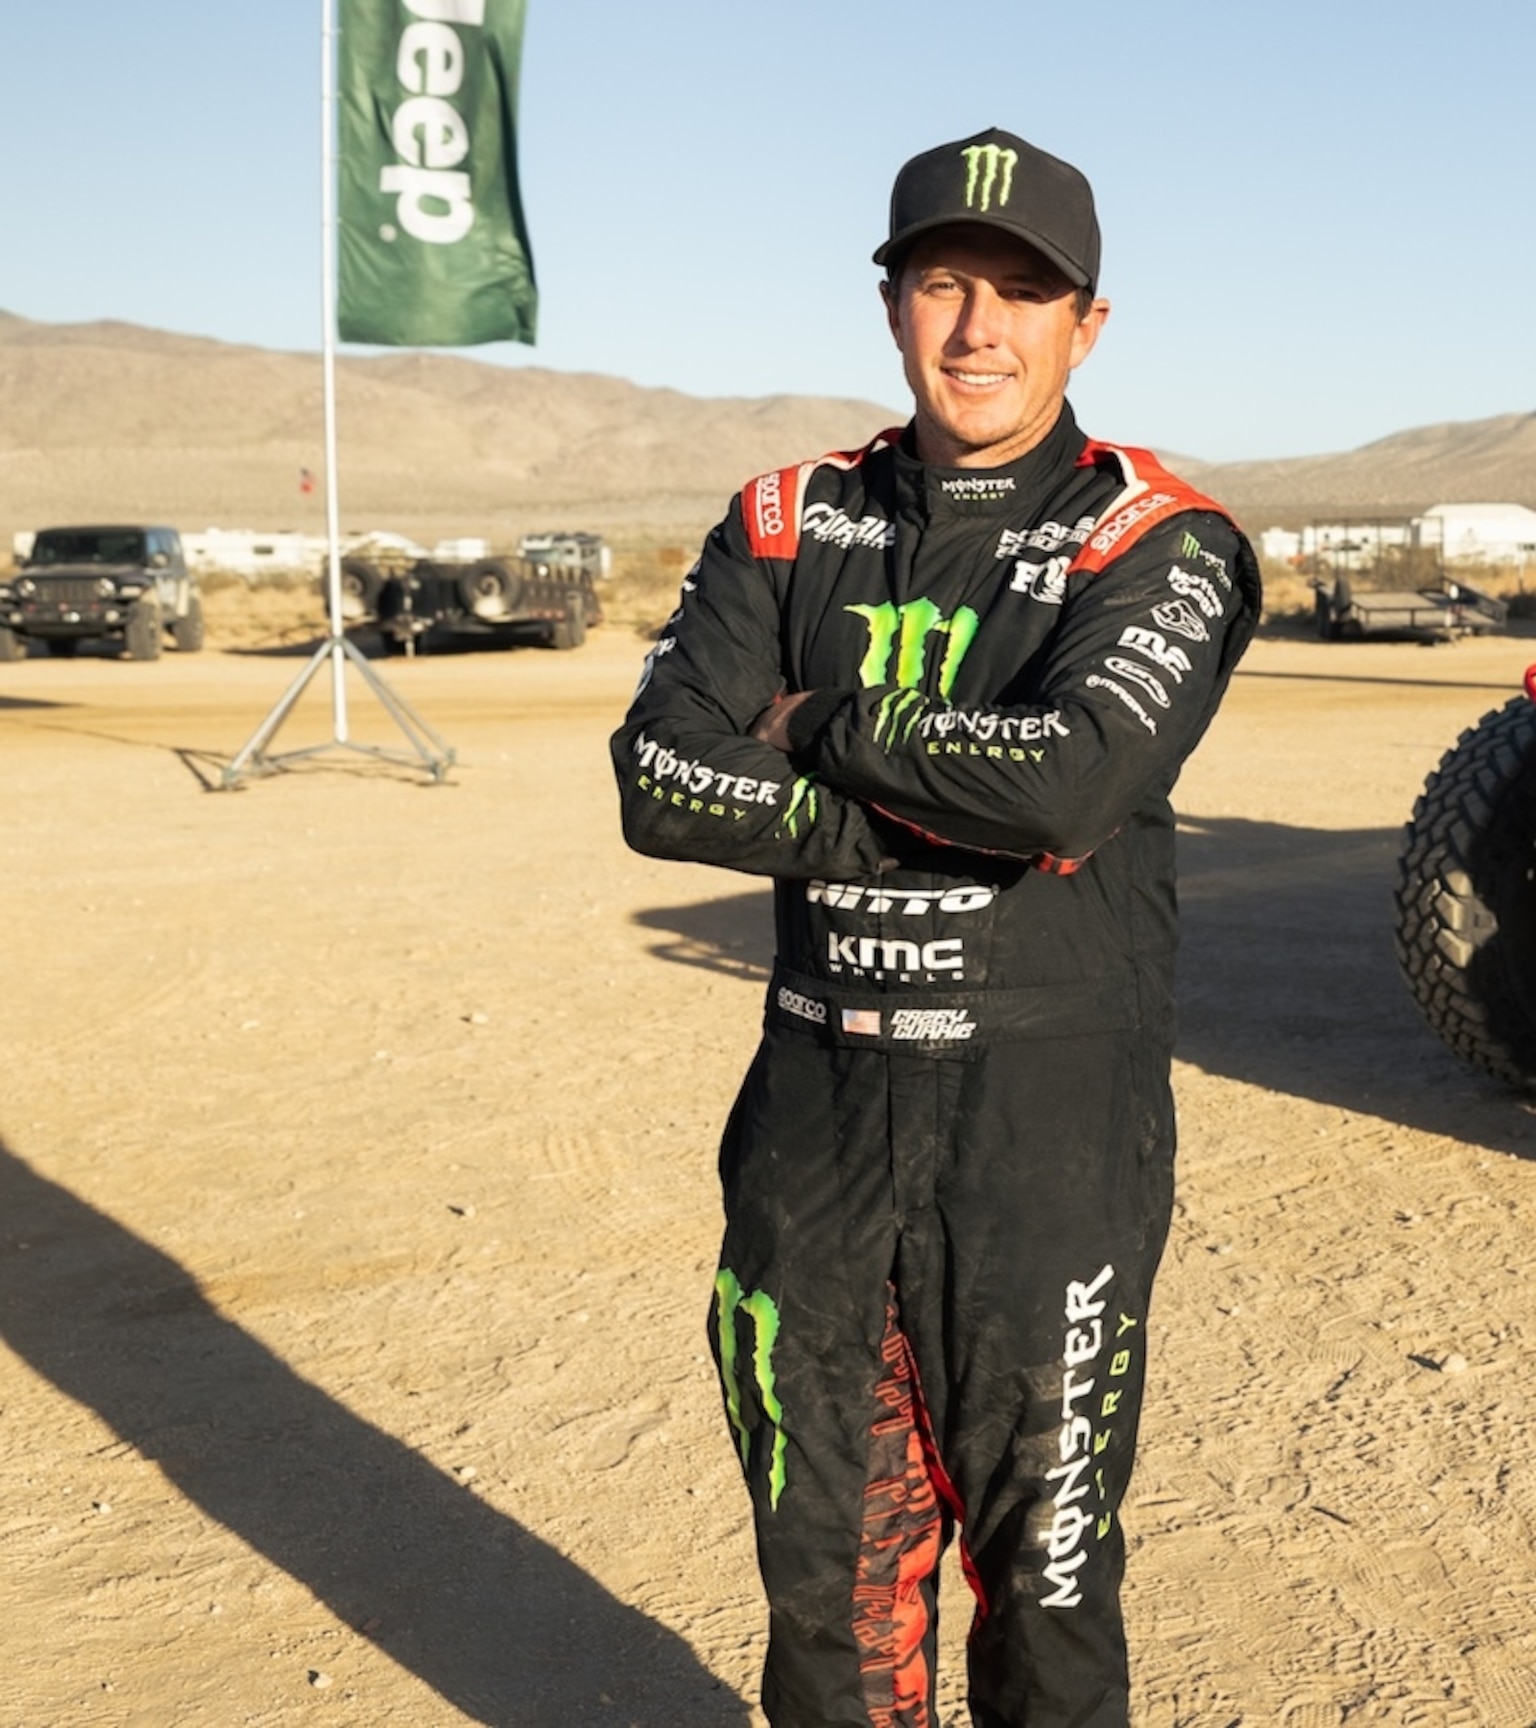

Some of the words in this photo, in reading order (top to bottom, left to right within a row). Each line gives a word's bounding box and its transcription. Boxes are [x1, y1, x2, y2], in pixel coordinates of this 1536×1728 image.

[941, 477, 1016, 493] MONSTER
[633, 731, 781, 806] MONSTER
[638, 774, 746, 821] ENERGY
[1038, 1264, 1114, 1608] MONSTER
